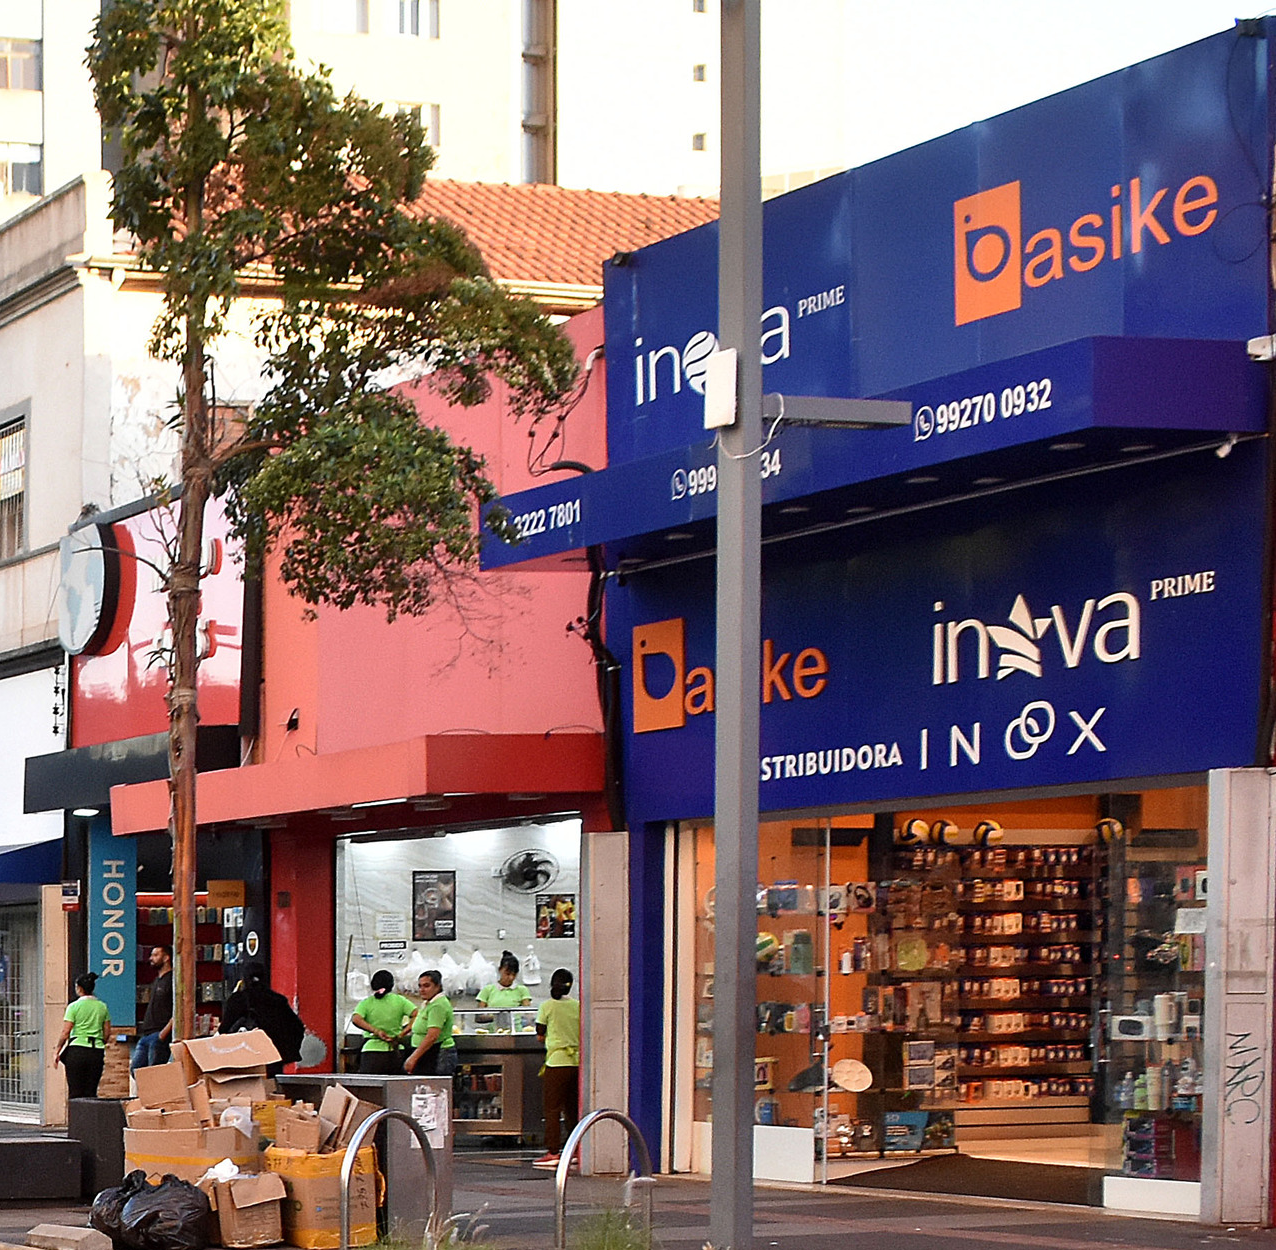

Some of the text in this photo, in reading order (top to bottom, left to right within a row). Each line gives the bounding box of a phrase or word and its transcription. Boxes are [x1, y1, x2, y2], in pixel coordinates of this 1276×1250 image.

[797, 284, 846, 319] PRIME
[936, 378, 1053, 434] 99270 0932
[687, 448, 782, 496] 999 34
[548, 498, 581, 530] 7801
[1149, 570, 1215, 601] PRIME
[760, 741, 904, 781] STRIBUIDORA
[102, 859, 125, 977] HONOR
